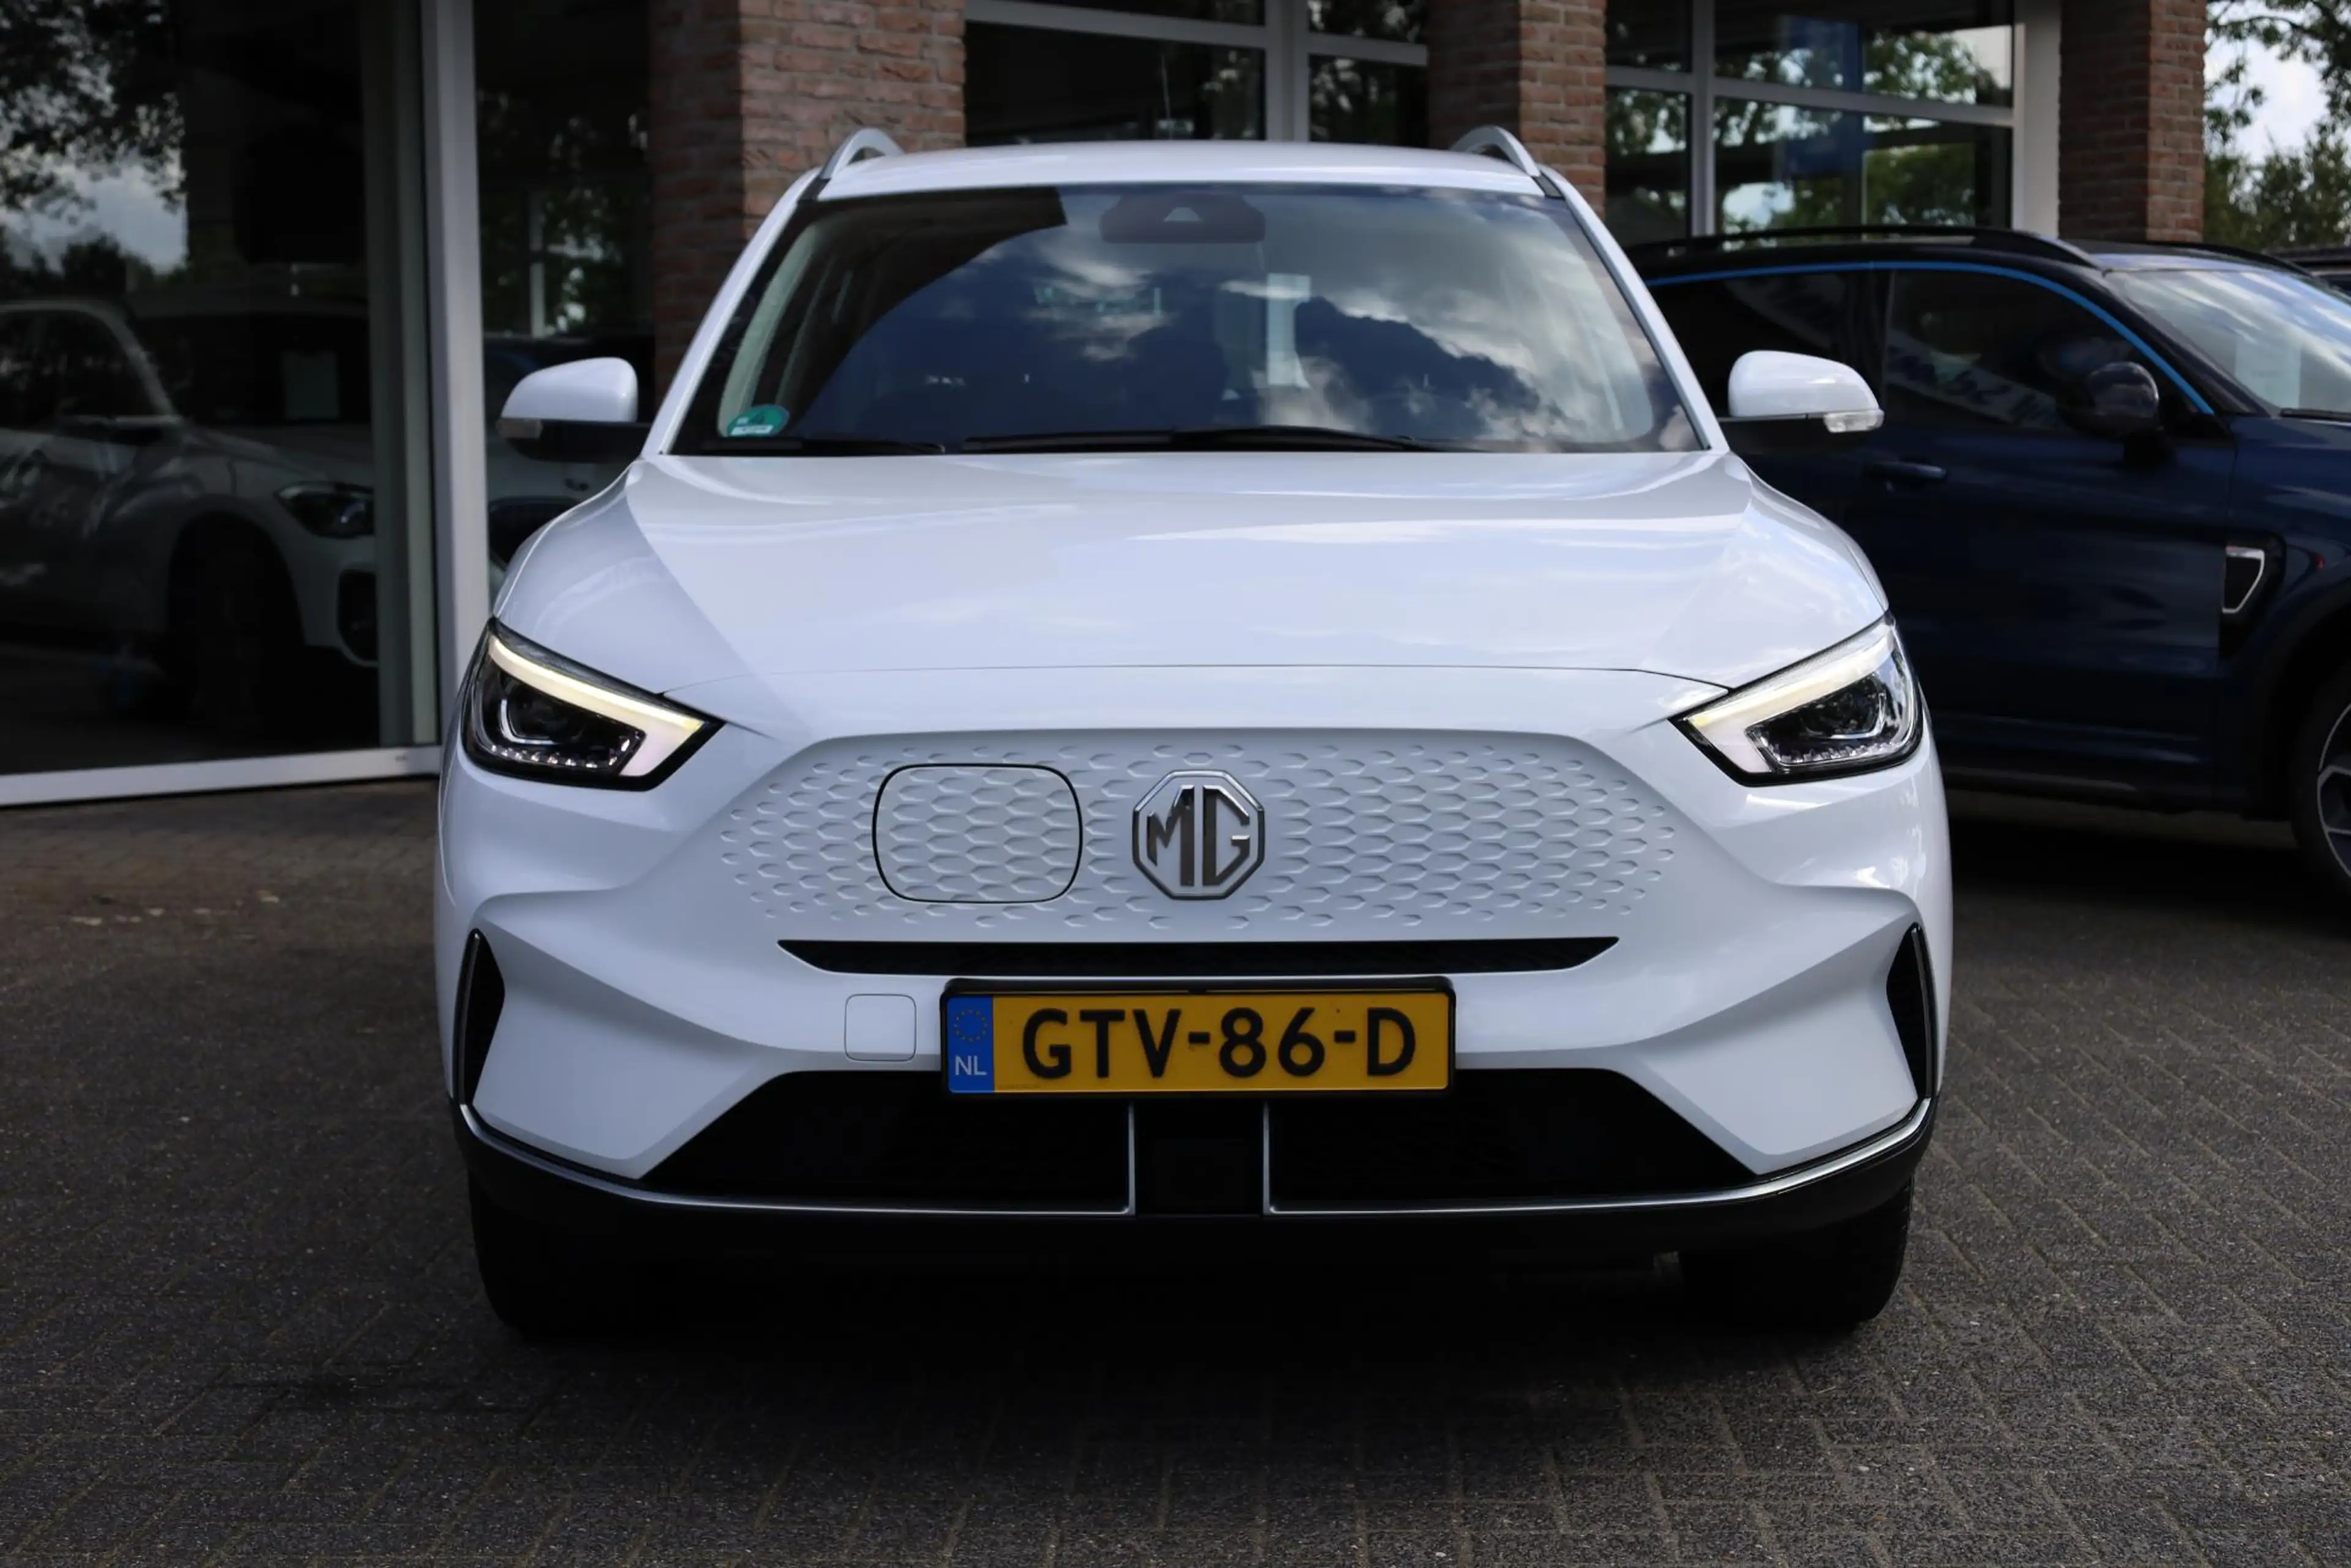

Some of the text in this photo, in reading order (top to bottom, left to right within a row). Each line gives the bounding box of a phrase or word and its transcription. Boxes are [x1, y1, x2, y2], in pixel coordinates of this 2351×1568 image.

[1147, 784, 1250, 887] MG
[955, 1055, 988, 1076] NL
[1022, 1008, 1415, 1079] GTV-86-D
